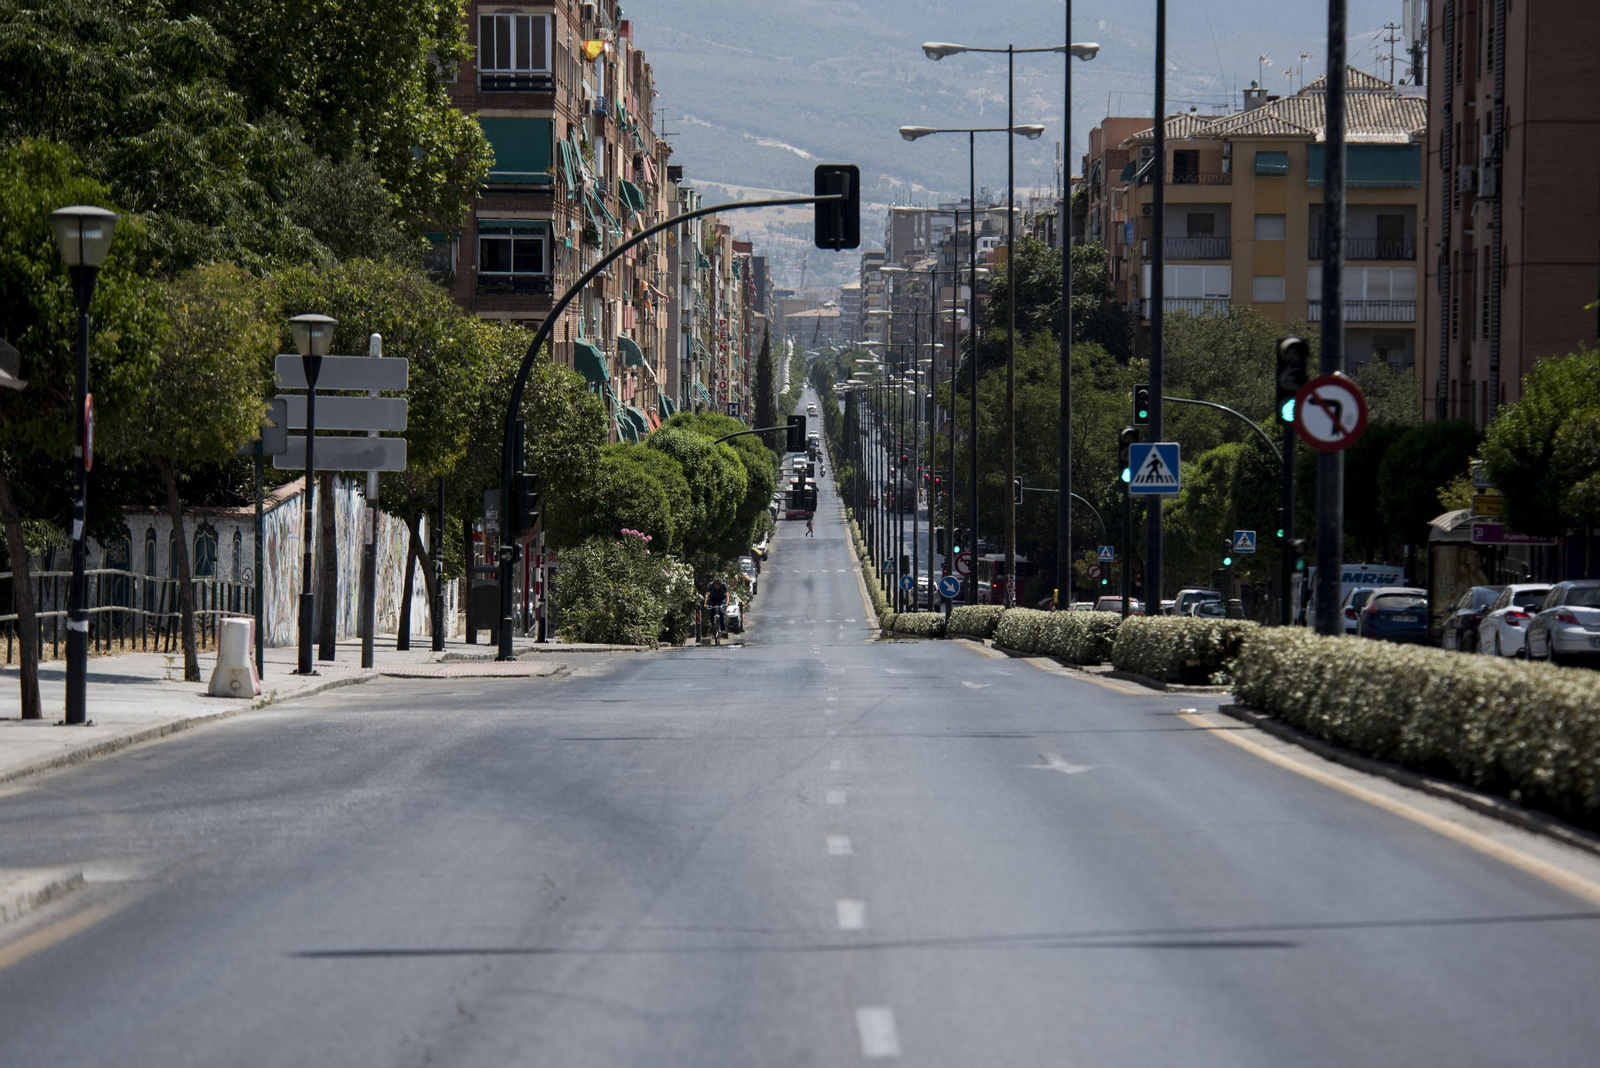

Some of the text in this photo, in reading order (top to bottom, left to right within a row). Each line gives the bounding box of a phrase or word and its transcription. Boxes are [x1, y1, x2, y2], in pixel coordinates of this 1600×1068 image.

[719, 319, 727, 402] PENSION
[729, 404, 739, 415] H
[1342, 572, 1399, 584] MRW
